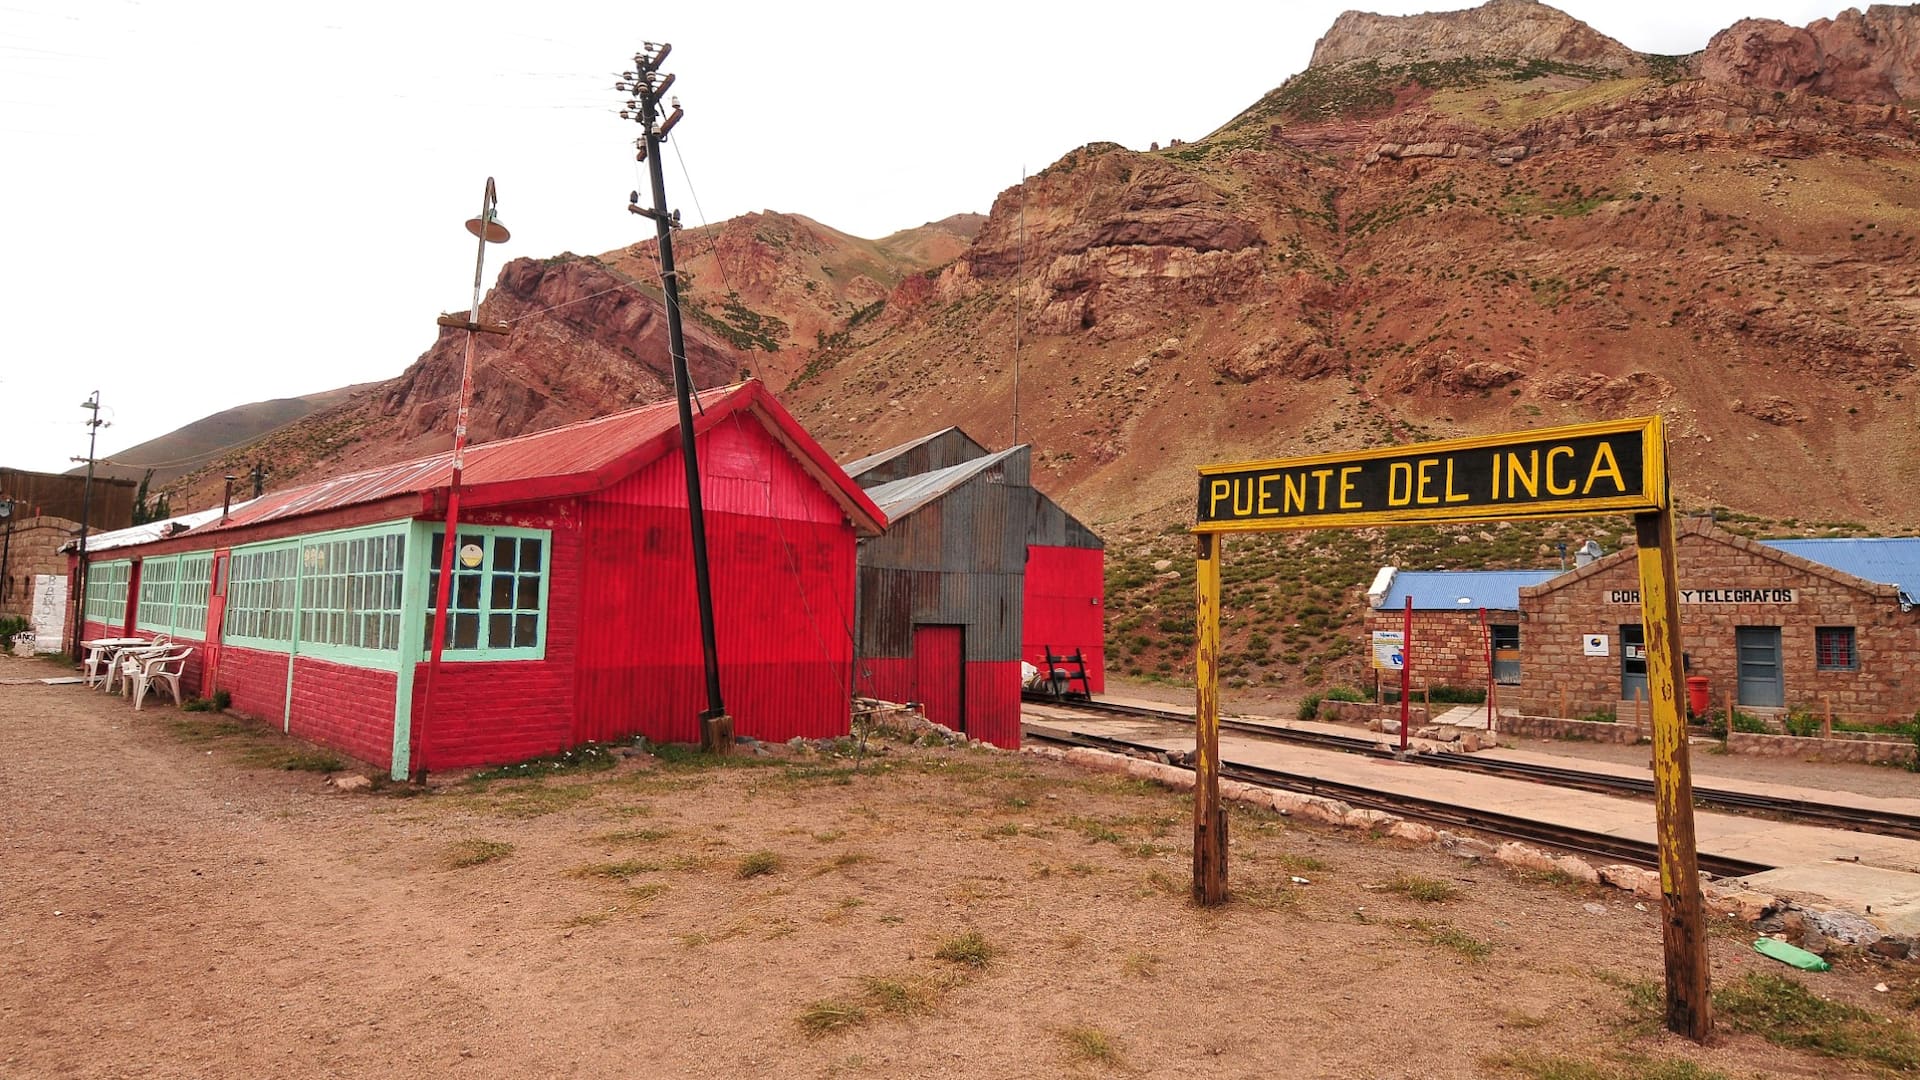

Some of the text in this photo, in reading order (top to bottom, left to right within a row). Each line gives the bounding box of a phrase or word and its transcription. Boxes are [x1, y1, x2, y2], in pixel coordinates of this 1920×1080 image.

[1210, 441, 1626, 518] PUENTE DEL INCA
[1681, 589, 1694, 603] Y
[1695, 589, 1792, 603] TELEGRAFOS
